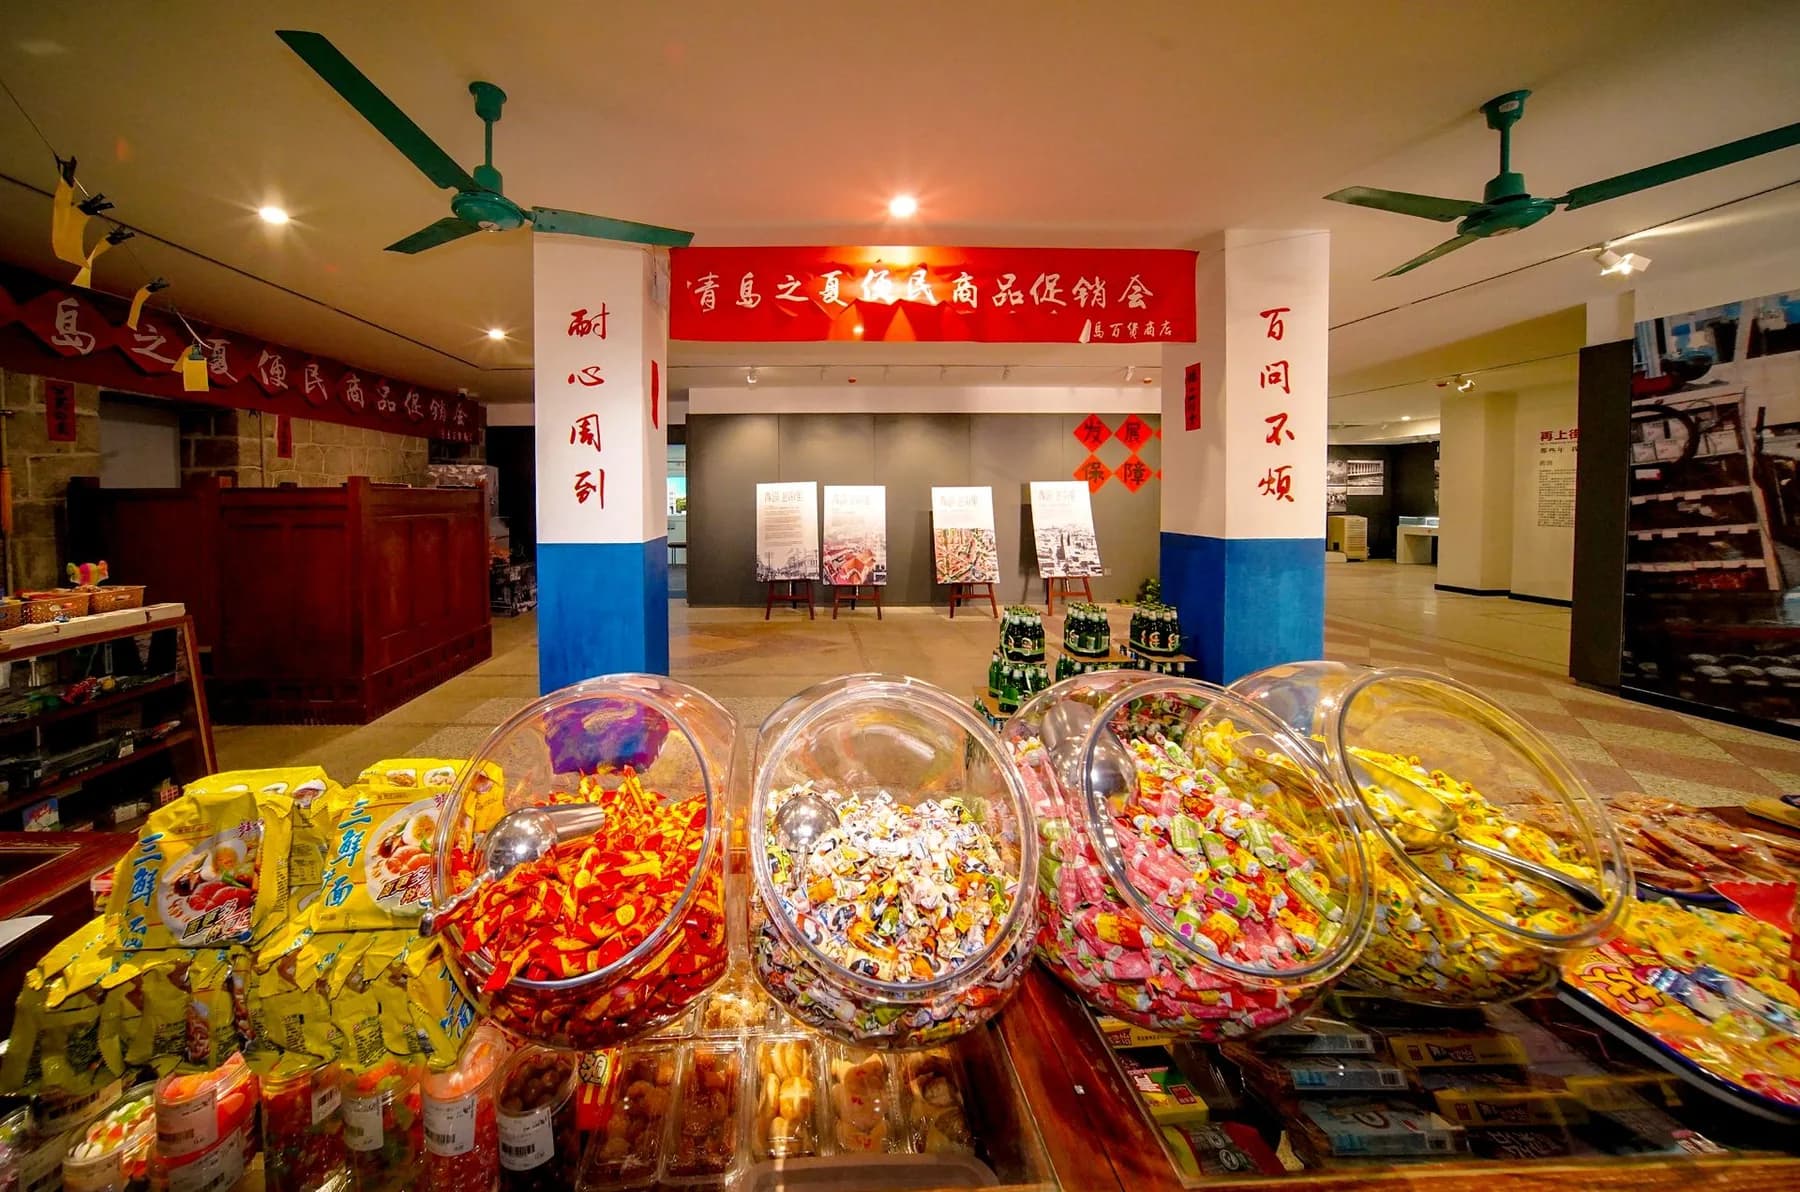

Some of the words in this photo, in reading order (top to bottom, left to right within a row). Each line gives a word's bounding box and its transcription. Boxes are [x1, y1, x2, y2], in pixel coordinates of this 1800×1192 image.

[567, 302, 610, 510] 耐心周到
[1258, 307, 1296, 502] 百问不烦
